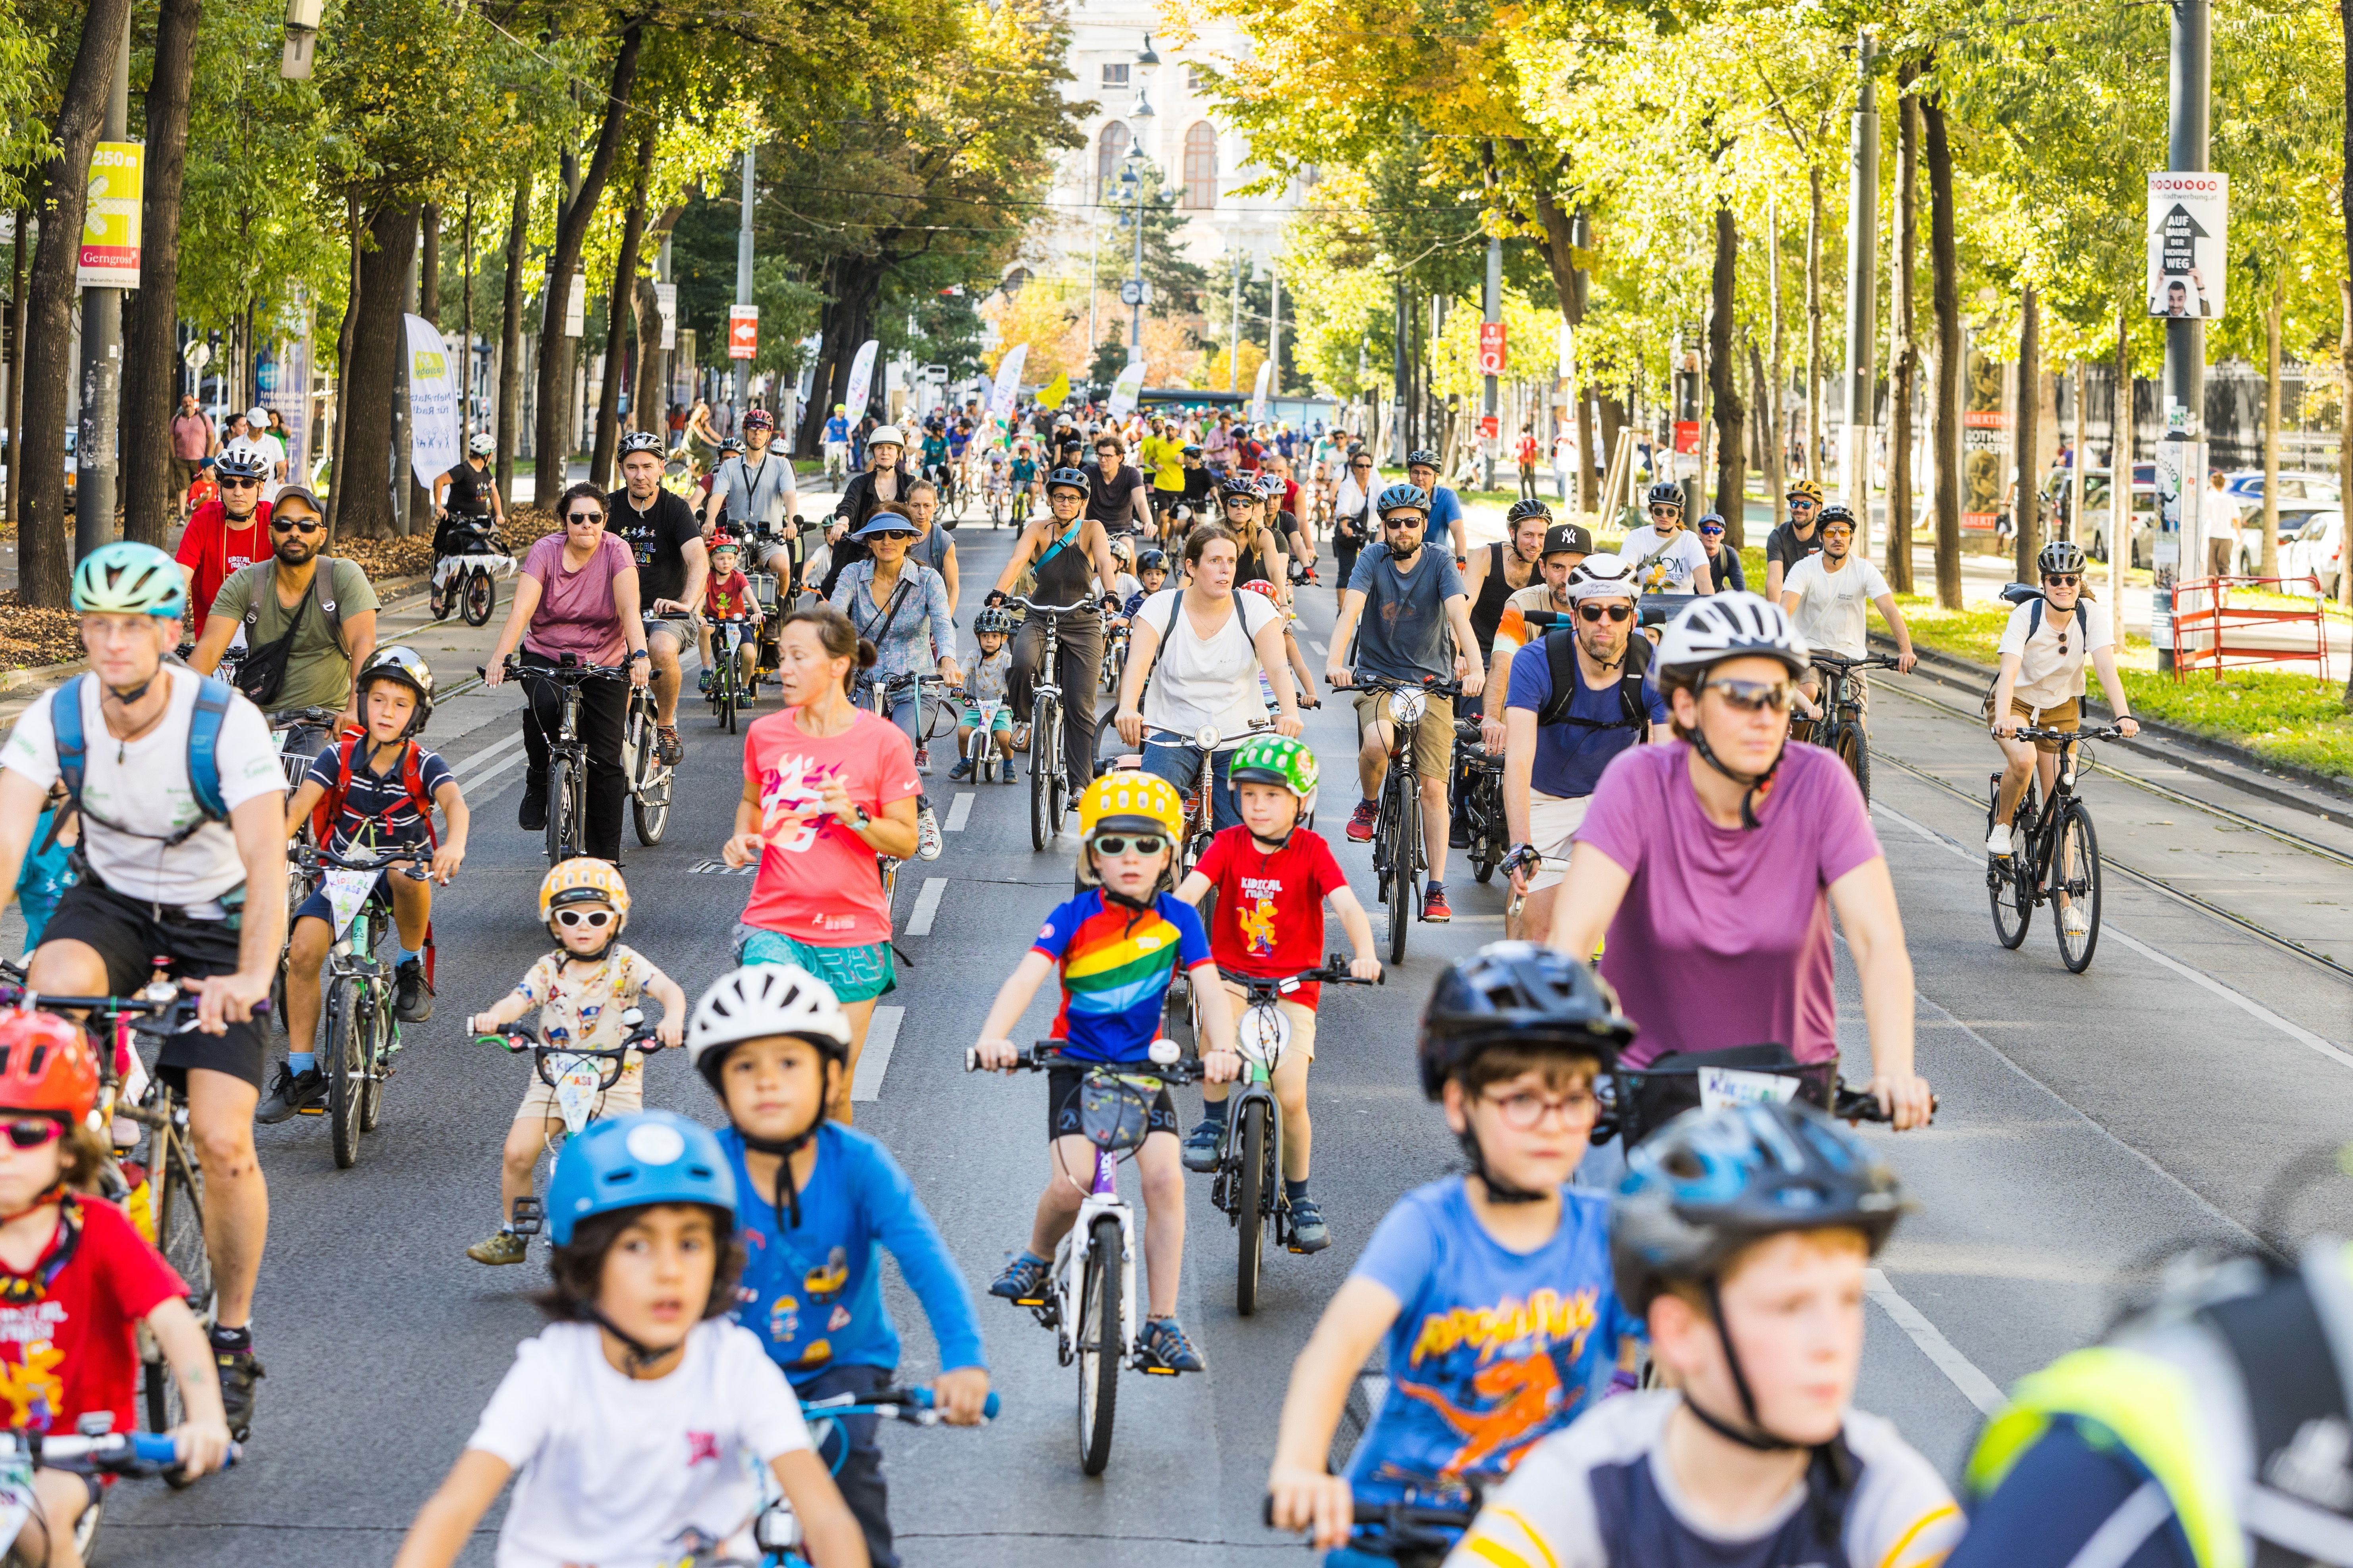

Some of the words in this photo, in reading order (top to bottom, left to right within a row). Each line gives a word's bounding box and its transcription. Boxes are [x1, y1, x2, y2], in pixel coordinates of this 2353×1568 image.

[93, 150, 123, 166] 250
[125, 156, 137, 167] m
[2153, 193, 2217, 202] .stadtwerbung.at
[2167, 215, 2189, 226] AUF
[2165, 227, 2192, 237] DAUER
[83, 252, 132, 266] Gerngross
[2166, 258, 2190, 269] WEG
[1965, 430, 2010, 443] GOTHIC
[1562, 528, 1576, 544] NY
[629, 542, 656, 553] DICAL
[635, 552, 651, 563] ASS
[1240, 876, 1283, 892] KIDICAL
[1245, 888, 1275, 900] MASS
